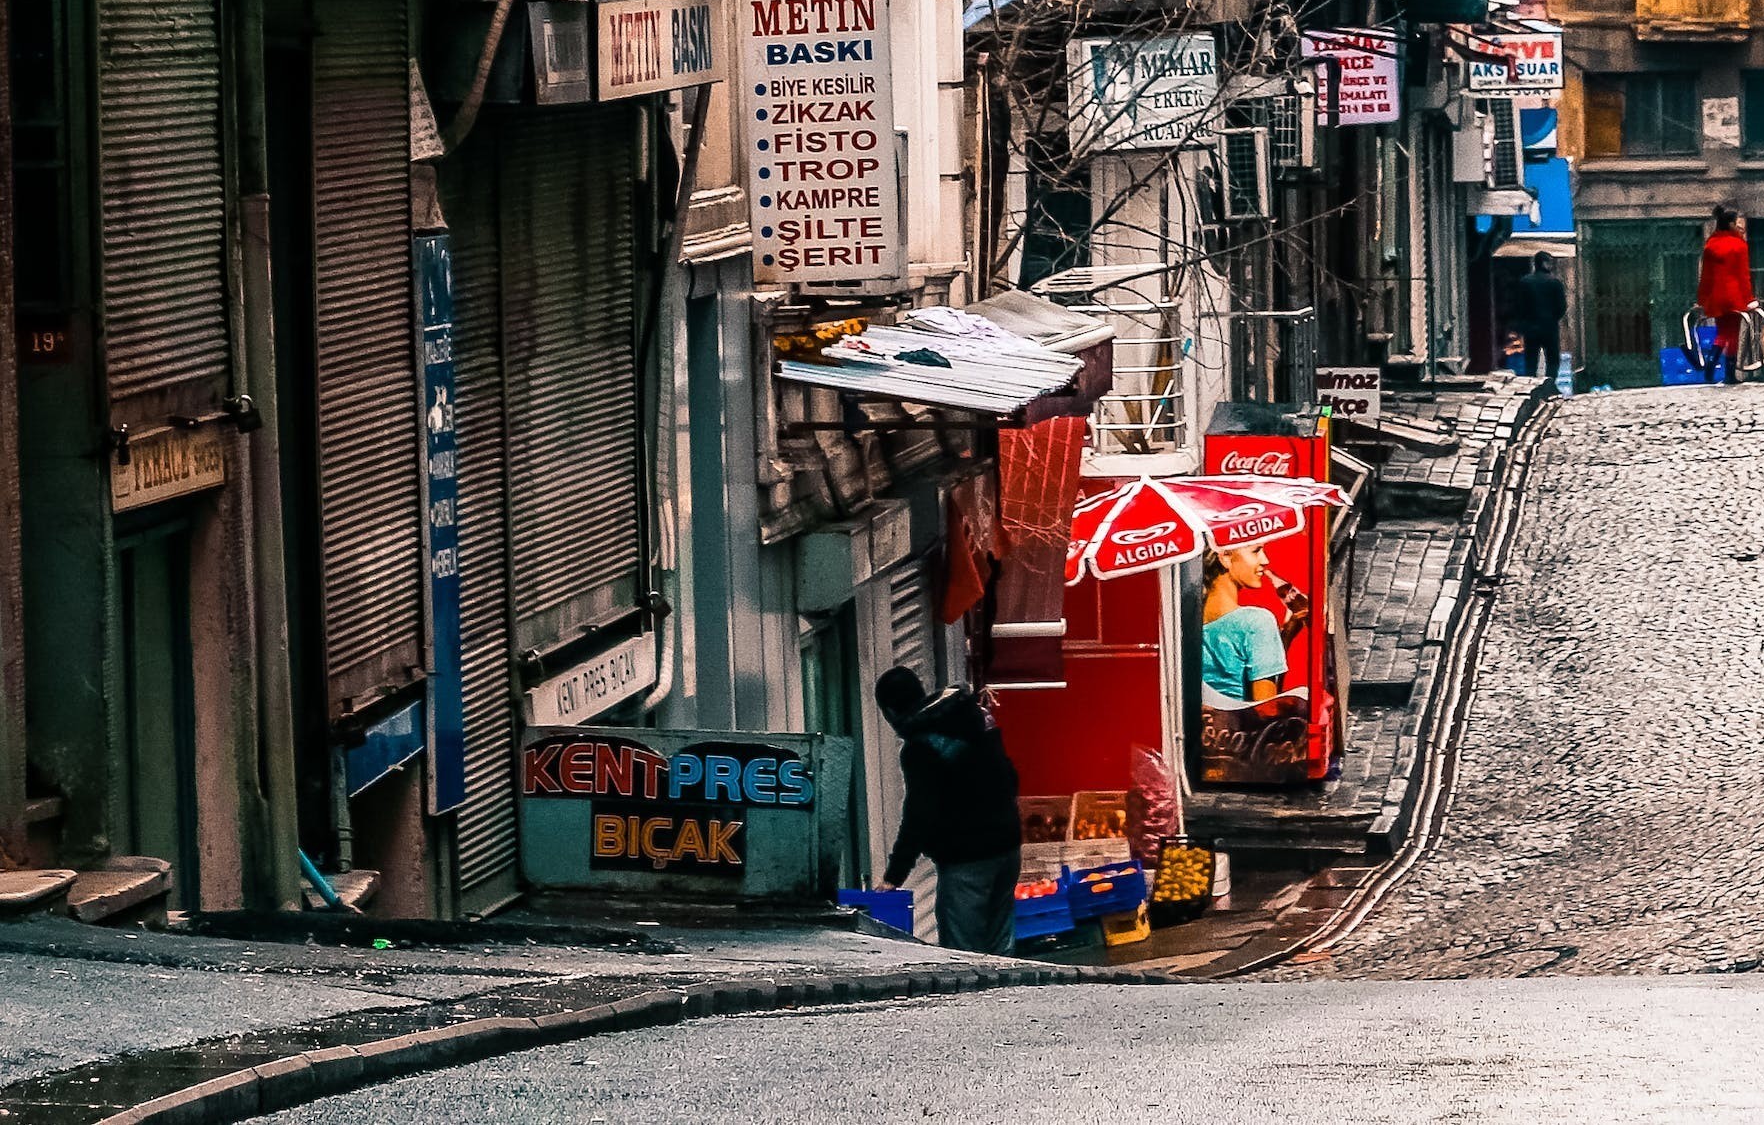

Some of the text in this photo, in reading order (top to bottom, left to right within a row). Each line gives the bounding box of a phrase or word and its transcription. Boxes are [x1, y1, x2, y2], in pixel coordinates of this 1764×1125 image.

[671, 4, 713, 75] BASKI
[765, 39, 874, 66] BASKI
[1471, 62, 1559, 77] AKSSUAR
[770, 72, 876, 97] BİYE KESİLİR
[771, 99, 876, 125] ZİKZAK
[774, 127, 878, 154] FİSTO
[774, 157, 880, 182] TROP
[775, 186, 881, 211] KAMPRE
[776, 214, 884, 246] ŞİLTE
[777, 241, 887, 273] ŞERİT
[522, 741, 815, 805] KENT PRES
[592, 813, 744, 870] BIÇAK
